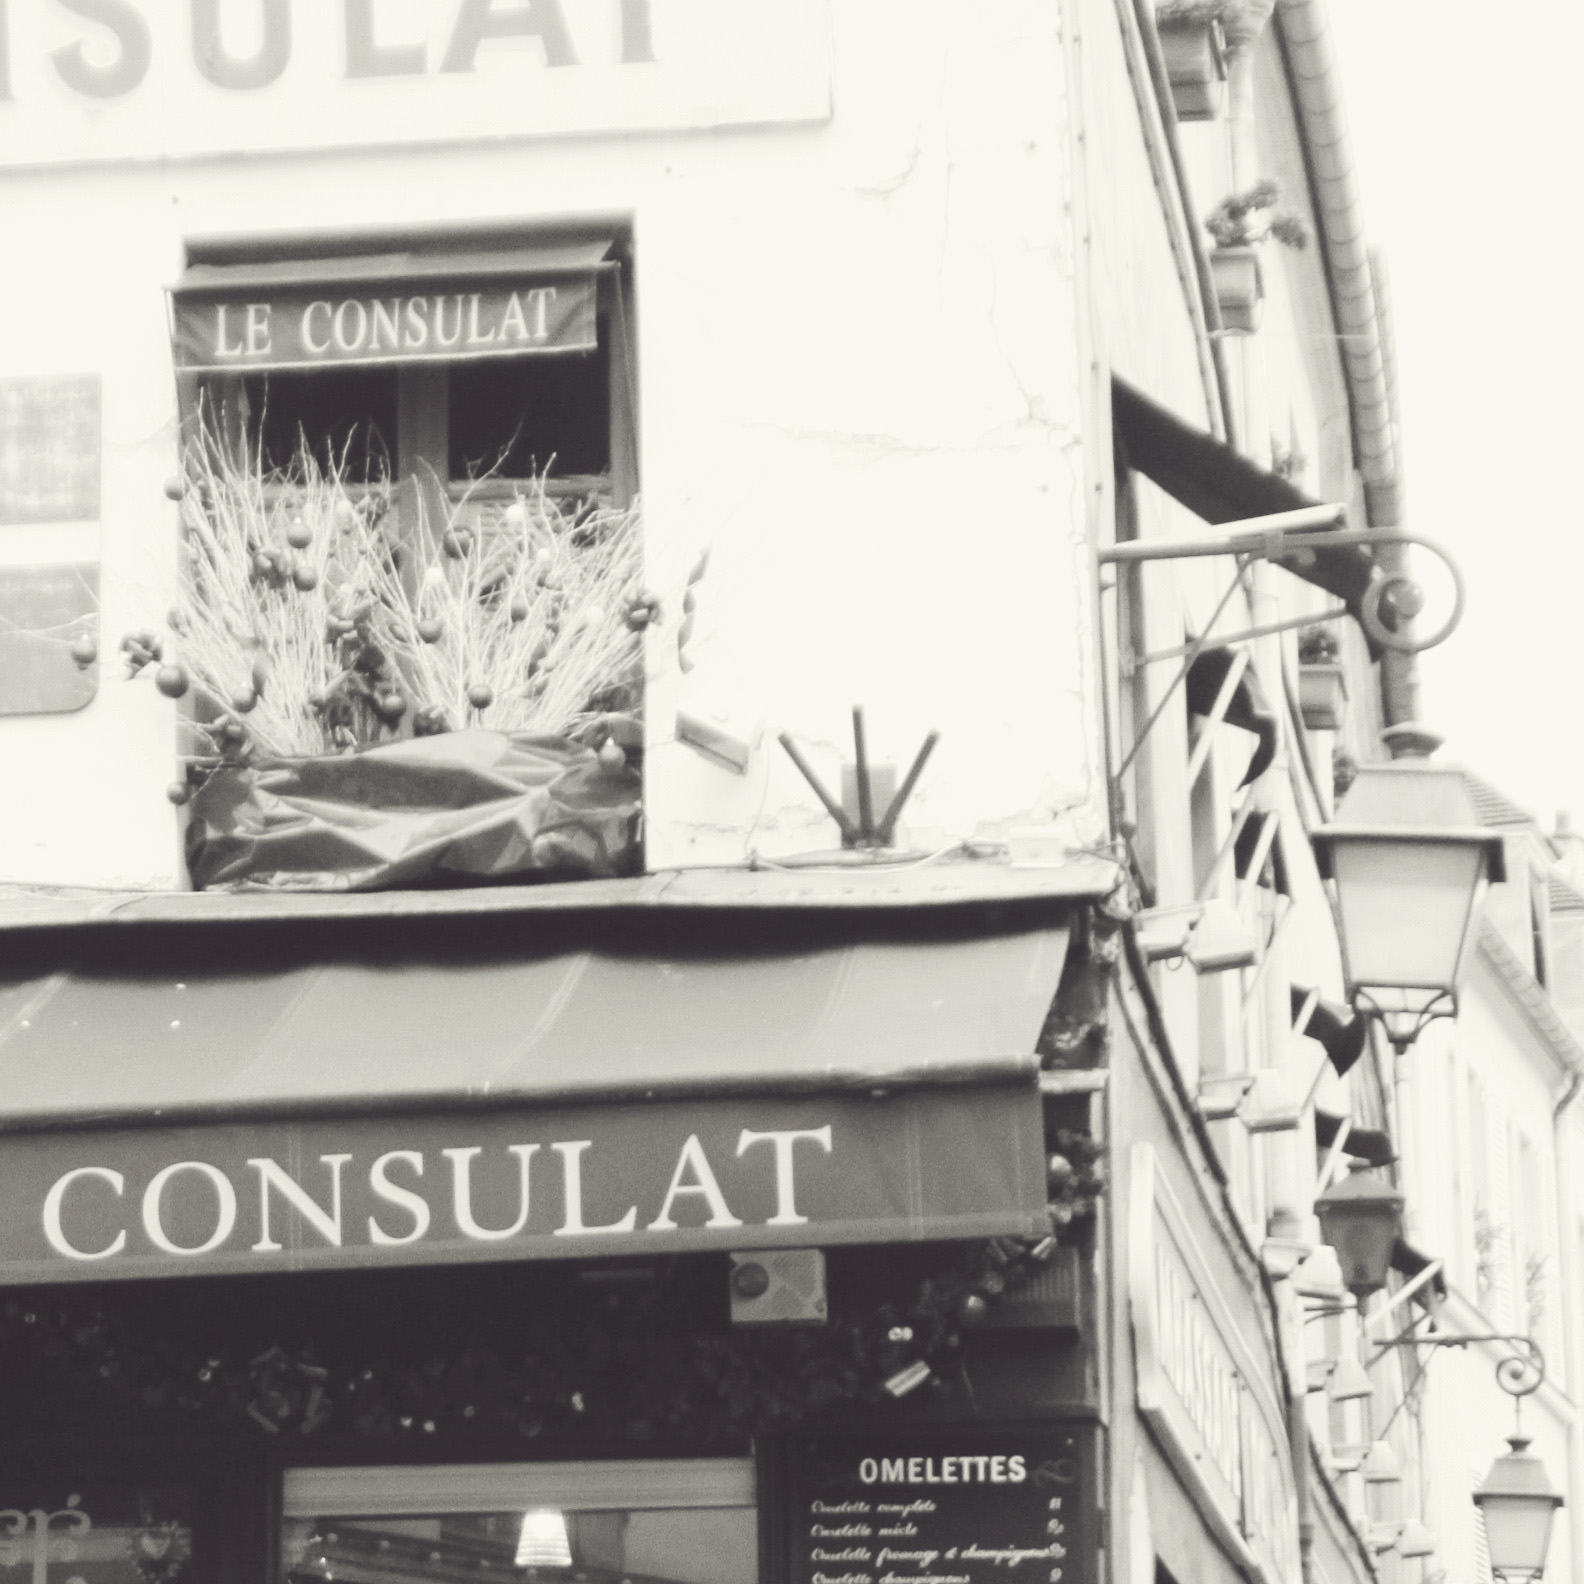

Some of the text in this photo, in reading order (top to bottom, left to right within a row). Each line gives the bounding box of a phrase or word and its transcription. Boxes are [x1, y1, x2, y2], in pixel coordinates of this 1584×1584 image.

[215, 287, 556, 356] LE CONSULAT
[43, 1126, 832, 1261] CONSULAT
[859, 1455, 1027, 1483] OMELETTES
[811, 1500, 870, 1514] Omelette
[811, 1523, 872, 1537] Omelette
[811, 1547, 871, 1561] Omelette
